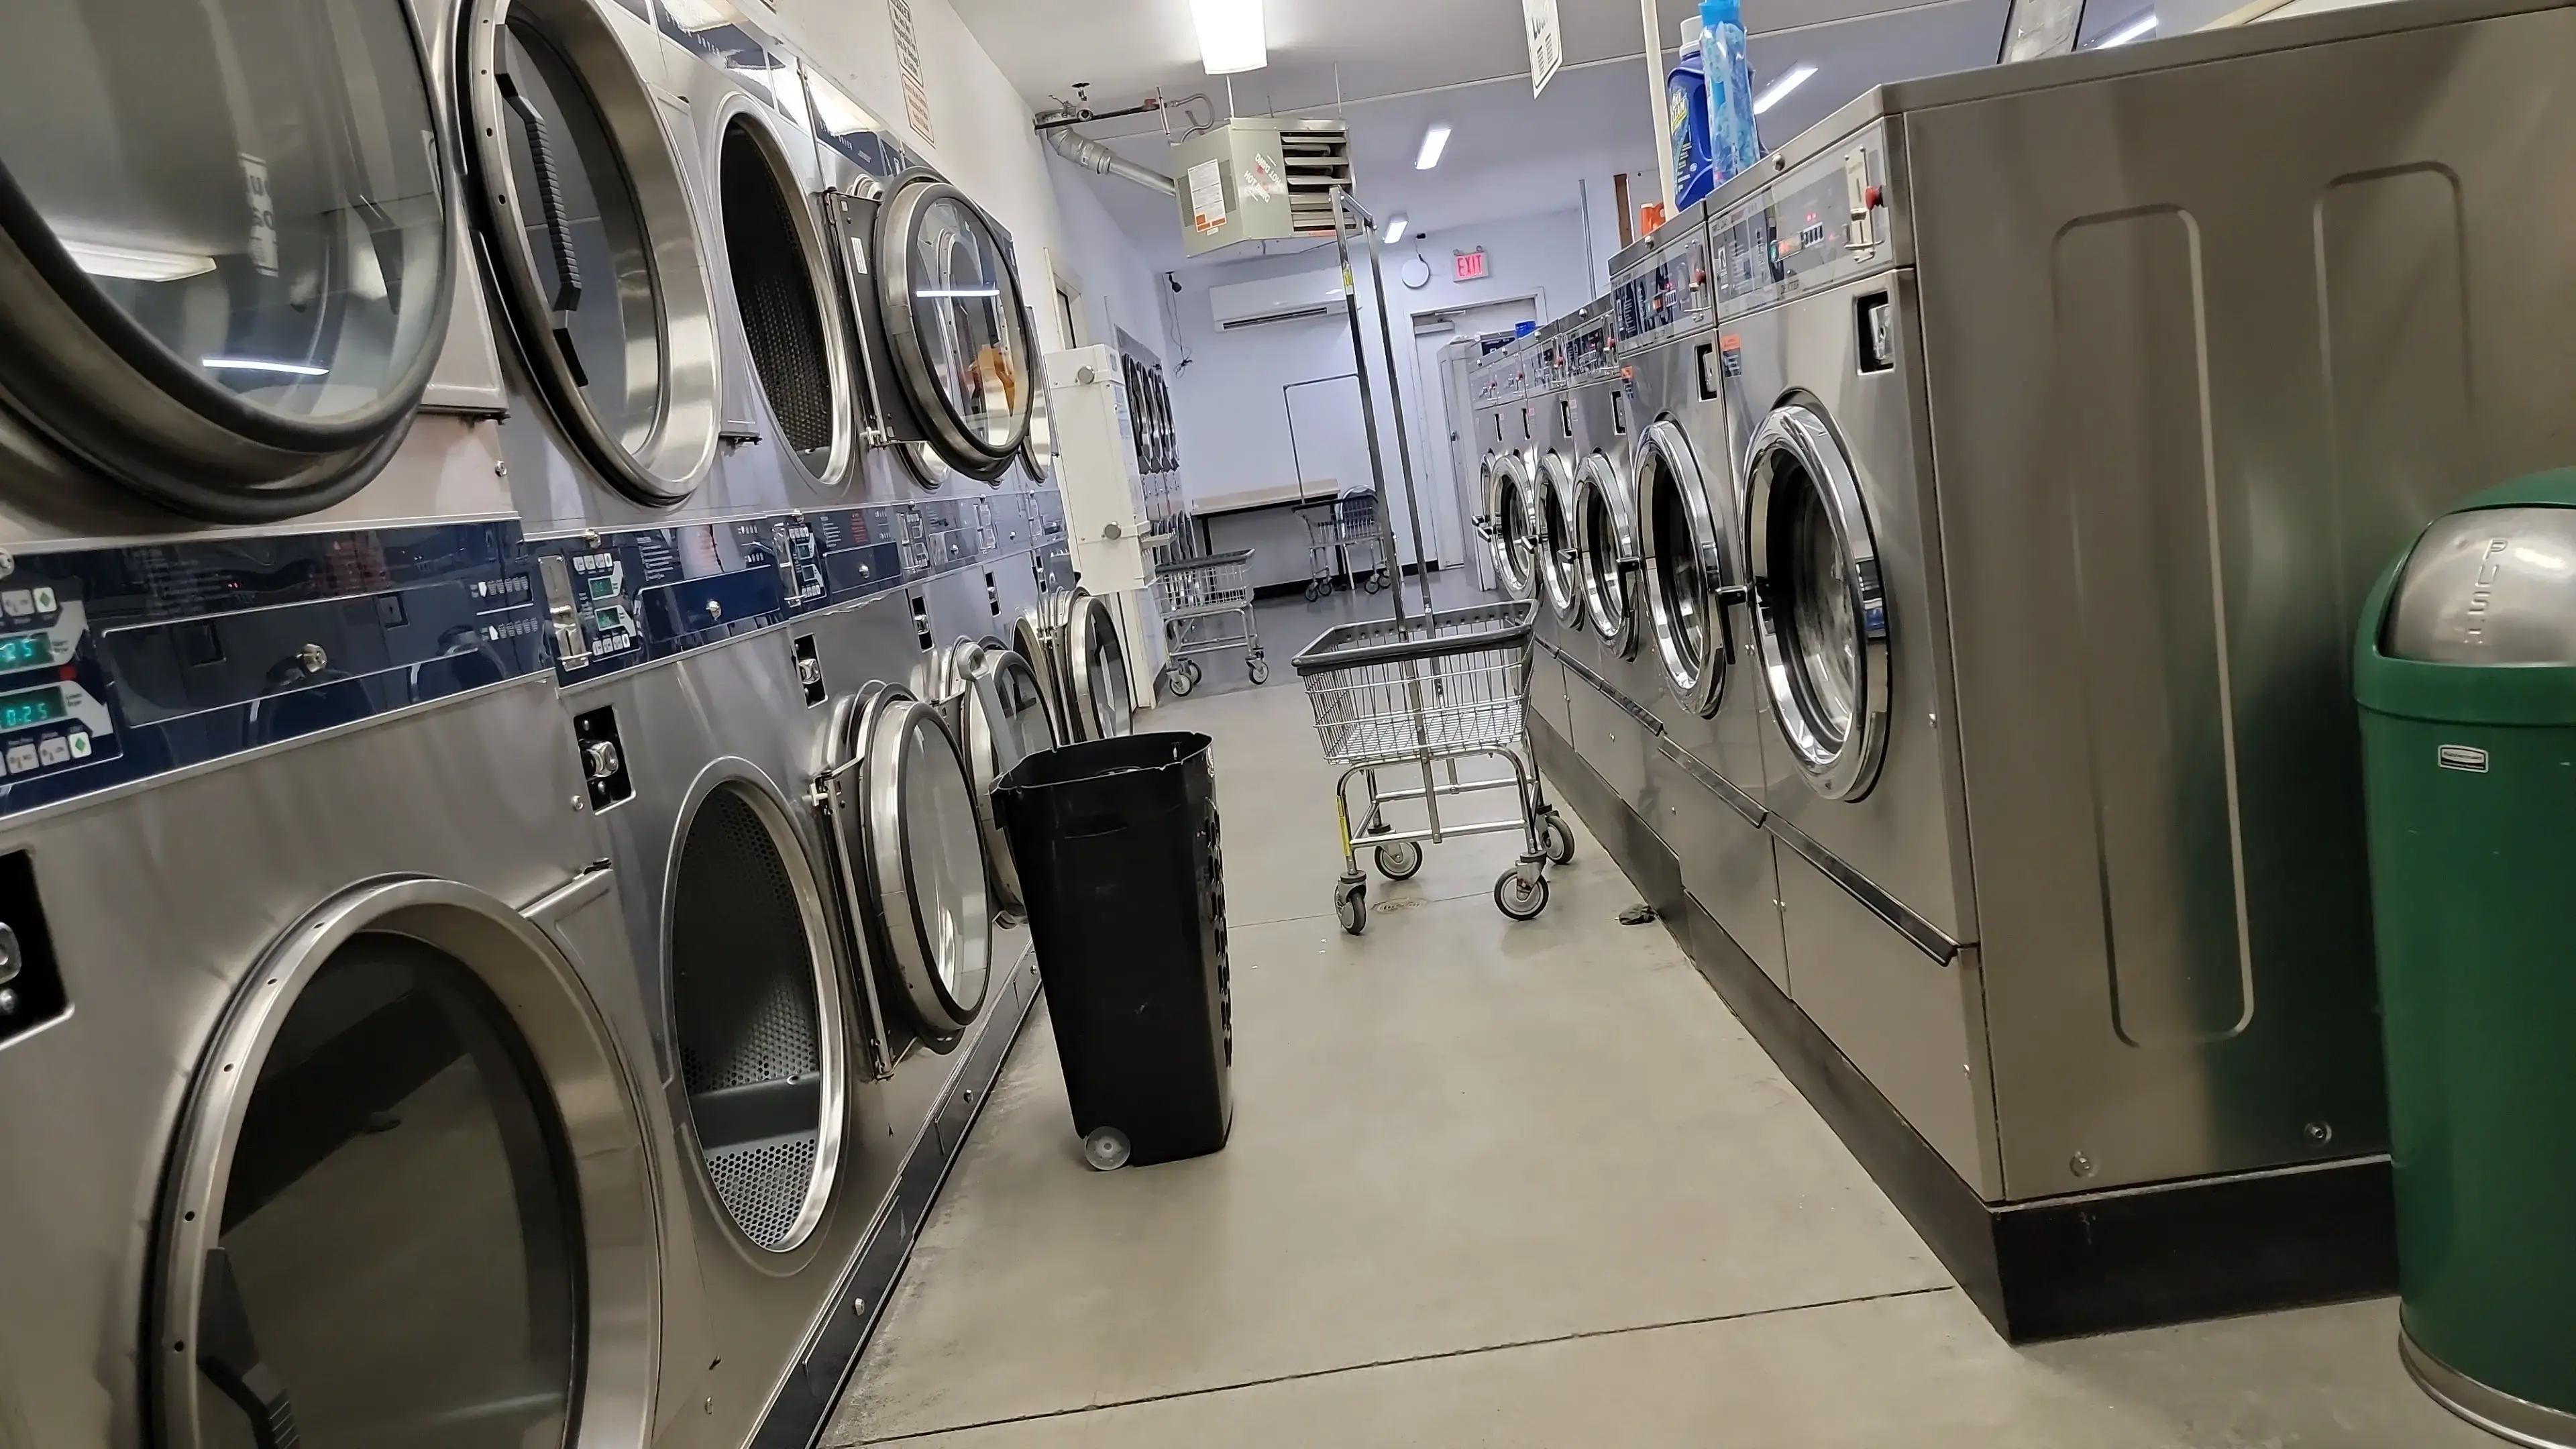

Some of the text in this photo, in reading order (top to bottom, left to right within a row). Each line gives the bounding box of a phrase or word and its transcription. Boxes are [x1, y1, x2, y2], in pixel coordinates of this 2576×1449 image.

[1244, 170, 1258, 186] HOT
[1457, 254, 1482, 277] EXIT
[2463, 538, 2509, 644] PUSH
